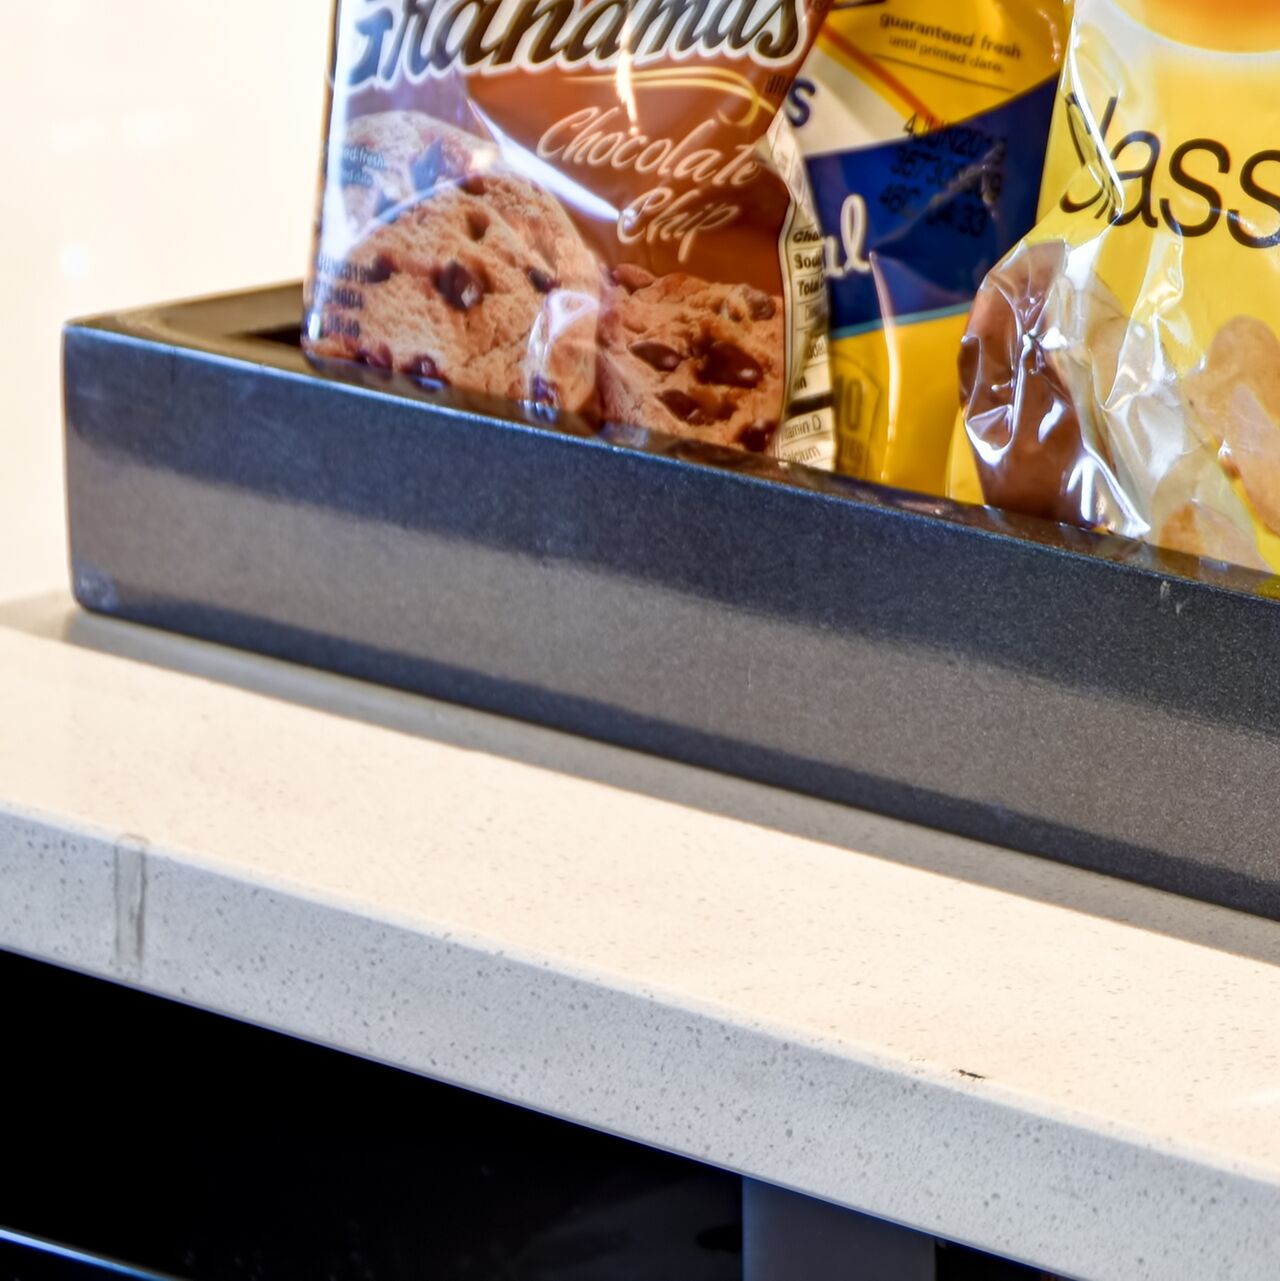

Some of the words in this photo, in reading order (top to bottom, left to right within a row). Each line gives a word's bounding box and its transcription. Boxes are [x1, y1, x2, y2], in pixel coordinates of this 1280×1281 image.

[879, 12, 977, 48] guaranteed
[979, 35, 1023, 61] fresh
[888, 36, 918, 52] until
[919, 42, 967, 65] printed
[536, 106, 760, 186] Chocolate
[617, 186, 740, 264] Chip
